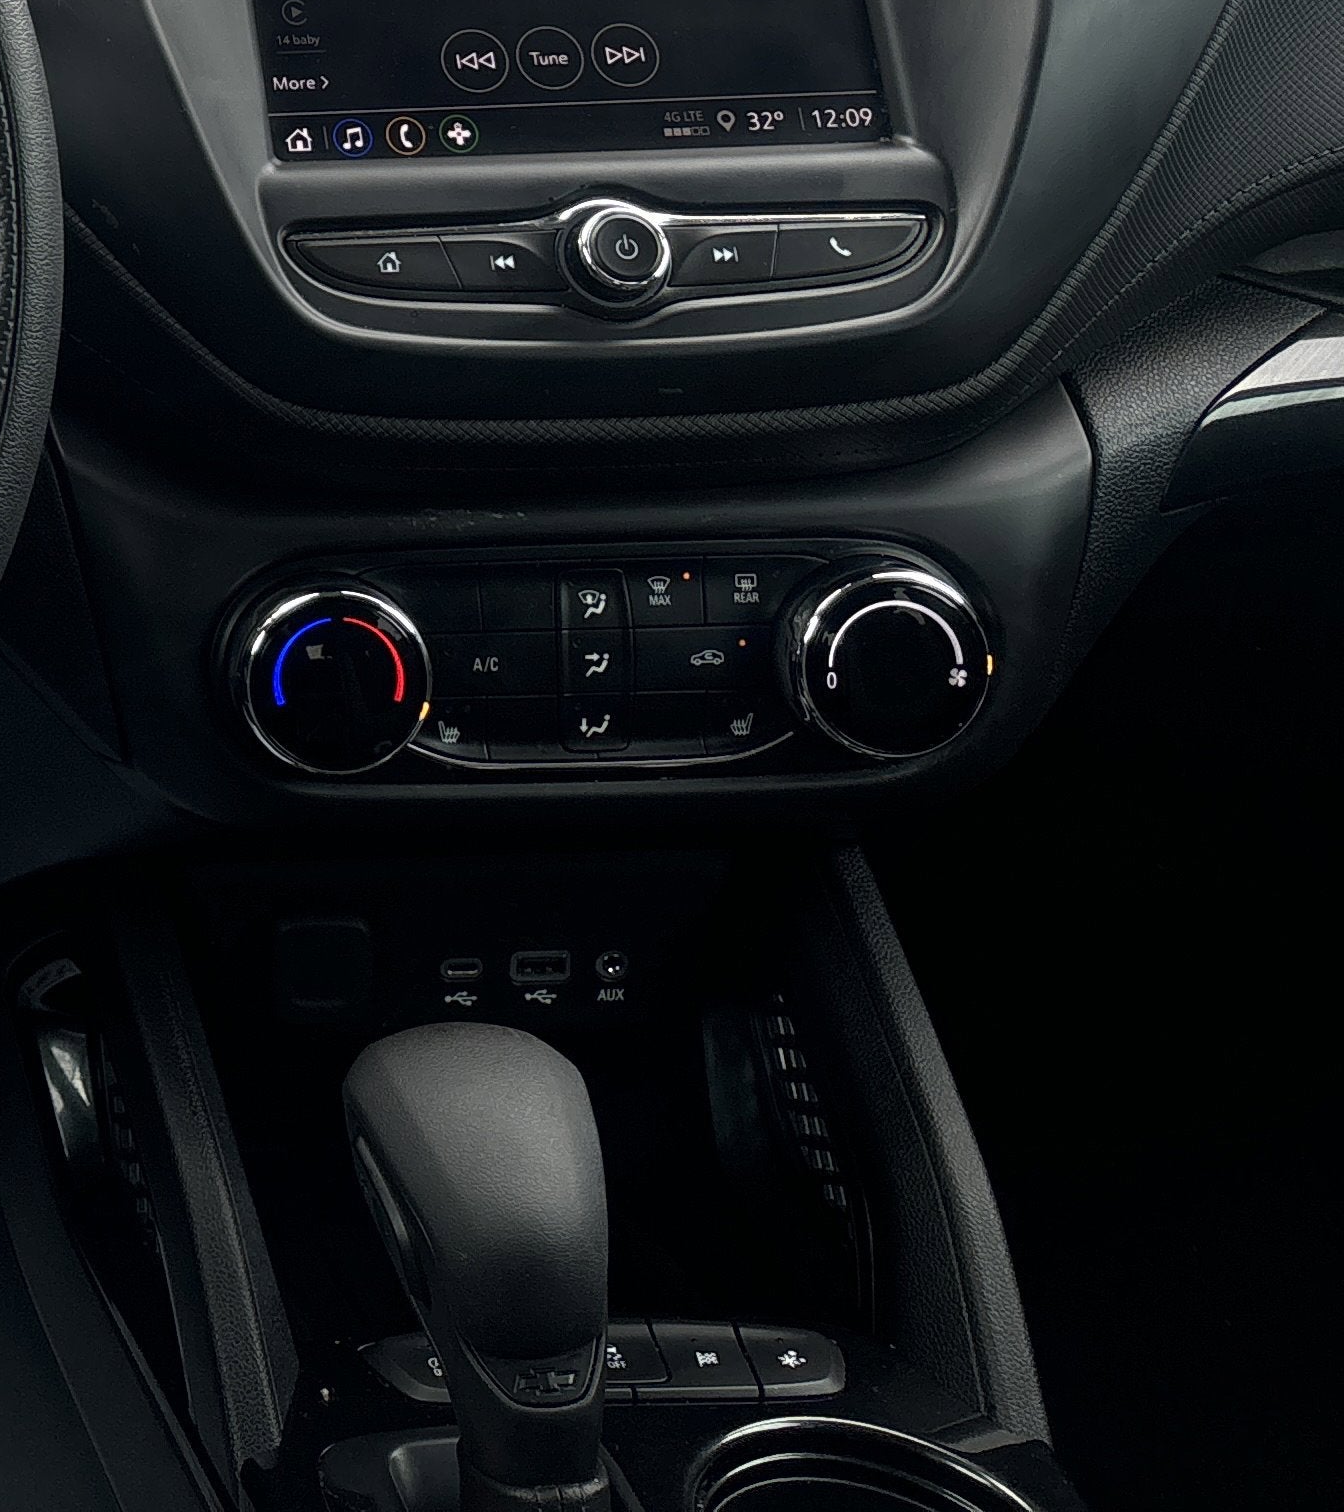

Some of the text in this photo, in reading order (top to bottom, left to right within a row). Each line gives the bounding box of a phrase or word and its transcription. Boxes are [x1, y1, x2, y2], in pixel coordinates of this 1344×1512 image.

[277, 34, 321, 47] 14 baby
[528, 51, 569, 66] Tune
[272, 76, 316, 91] More
[663, 110, 705, 123] 4G LTE
[811, 107, 873, 129] 12:09
[648, 594, 672, 607] MAX
[733, 591, 760, 604] REAR
[472, 656, 500, 673] A/C
[826, 671, 837, 690] 0
[596, 988, 625, 1001] AUX
